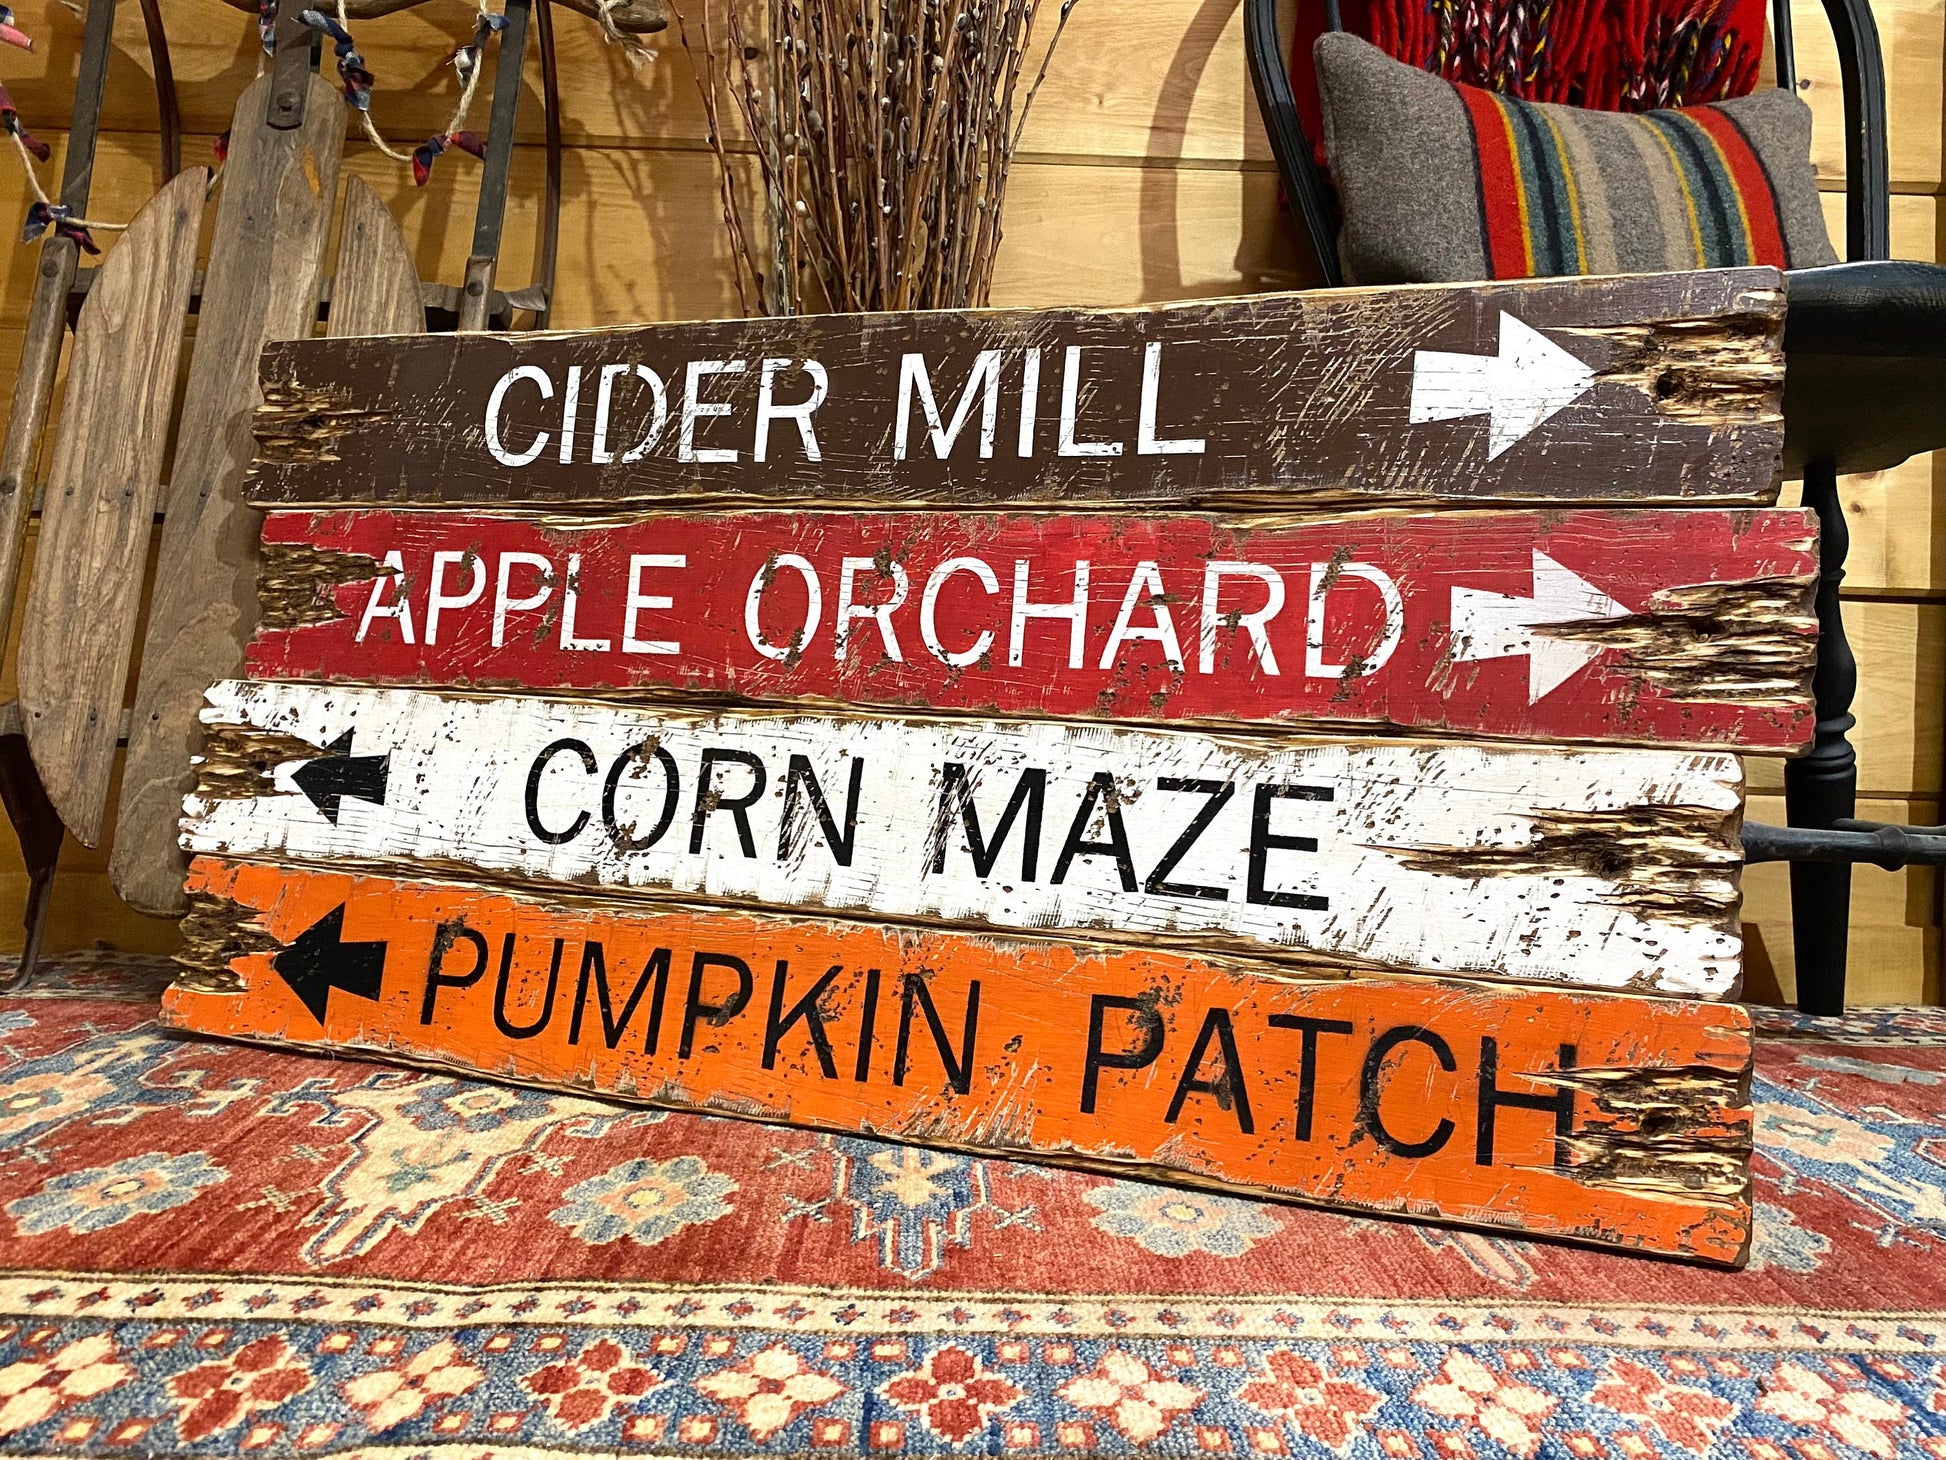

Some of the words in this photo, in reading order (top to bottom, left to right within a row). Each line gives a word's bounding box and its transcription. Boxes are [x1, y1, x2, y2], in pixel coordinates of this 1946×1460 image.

[483, 358, 830, 468] CIDER
[893, 341, 1207, 461] MILL
[355, 551, 688, 656] APPLE
[744, 552, 1406, 680] ORCHARD
[525, 737, 862, 867] CORN
[932, 762, 1336, 912] MAZE
[420, 919, 985, 1096] PUMPKIN
[1079, 993, 1578, 1169] PATCH
